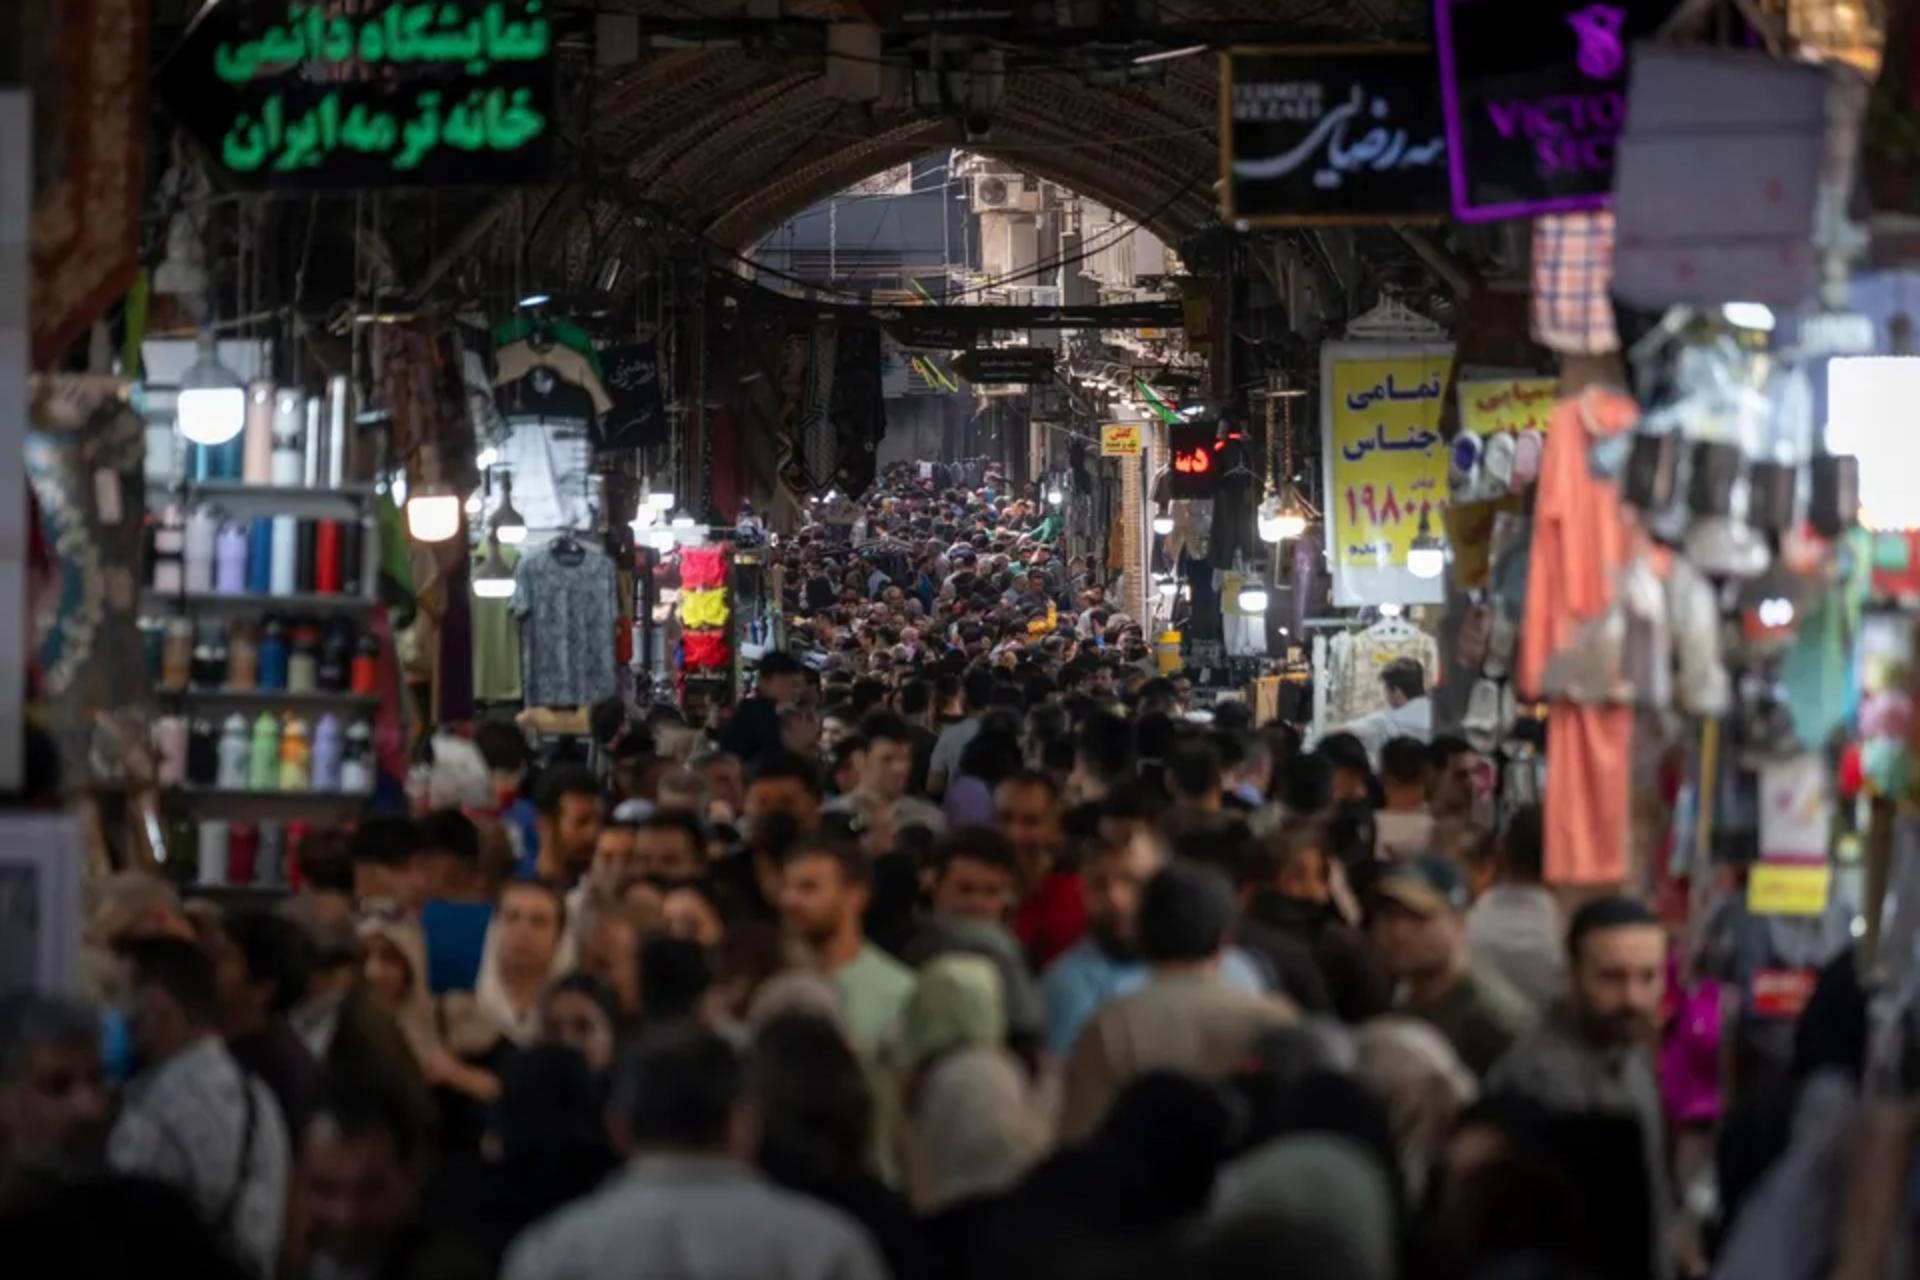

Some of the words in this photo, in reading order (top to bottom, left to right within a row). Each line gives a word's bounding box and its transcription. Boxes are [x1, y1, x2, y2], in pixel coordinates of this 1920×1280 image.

[222, 90, 341, 173] ایران
[443, 86, 546, 151] خانه
[1346, 371, 1441, 411] تمامی
[1343, 420, 1446, 462] جناس
